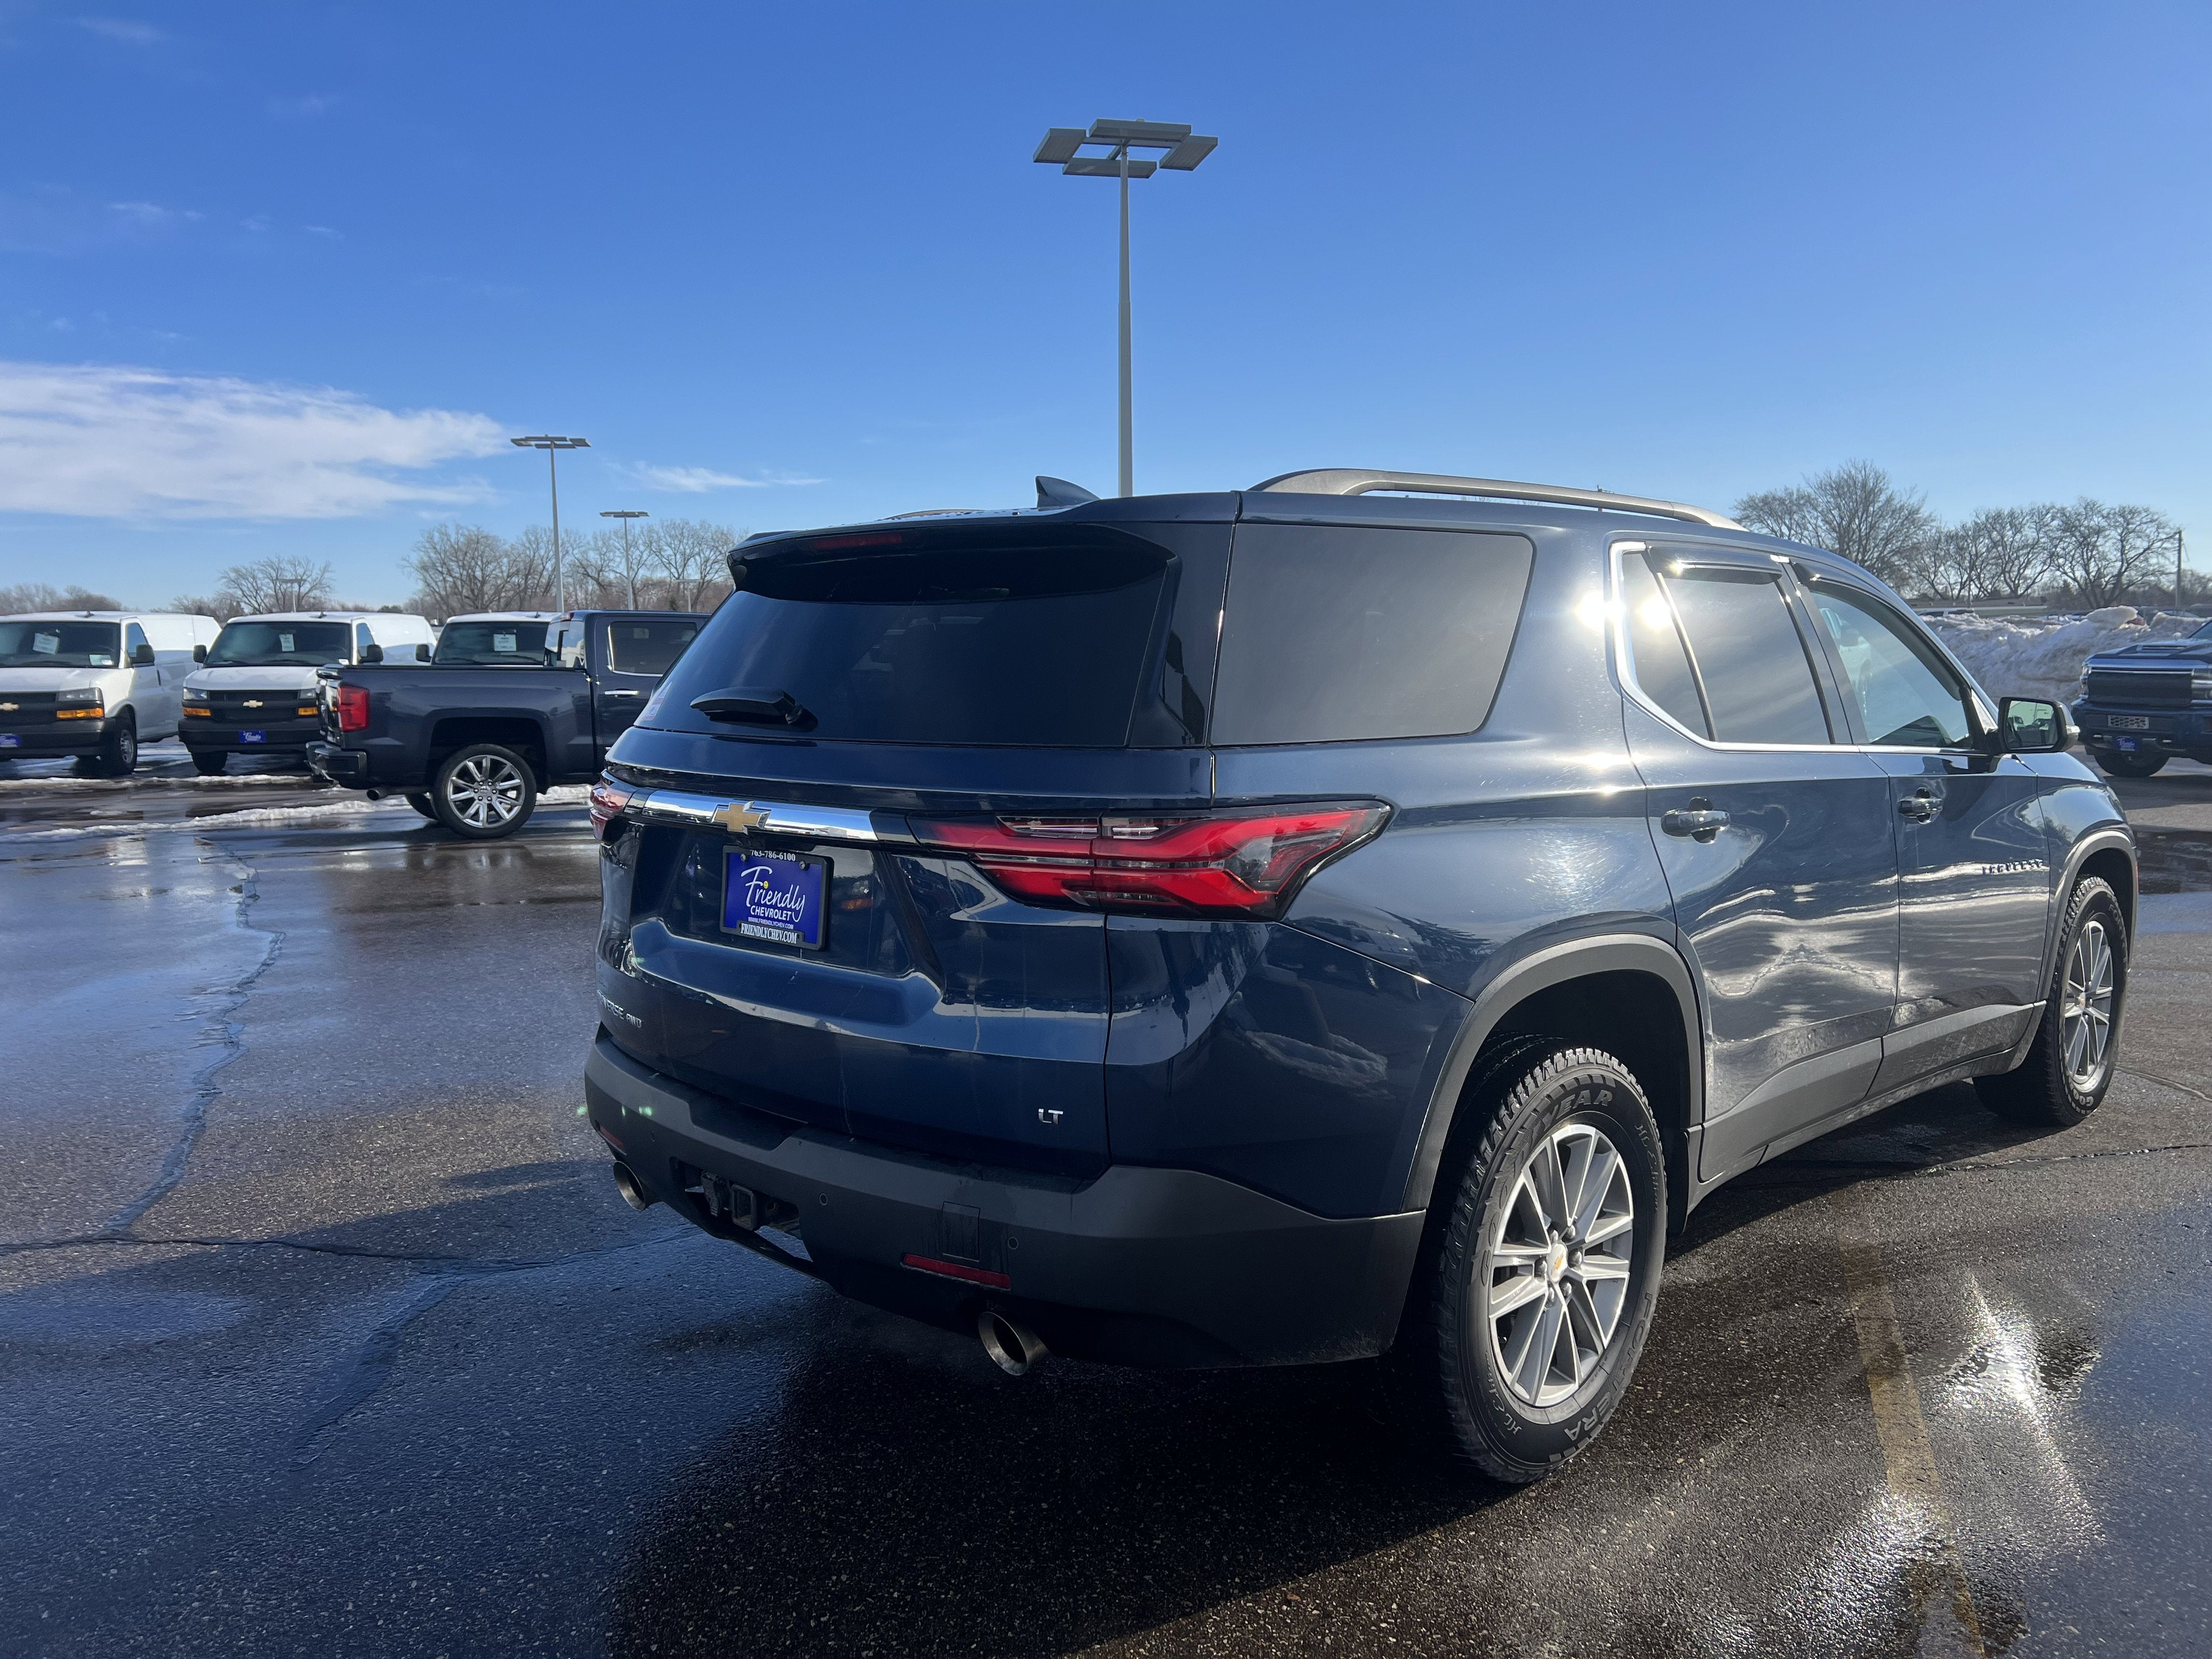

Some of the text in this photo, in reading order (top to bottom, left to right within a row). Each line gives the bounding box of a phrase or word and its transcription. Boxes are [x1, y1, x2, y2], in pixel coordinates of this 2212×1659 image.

[750, 849, 795, 861] 763-786-6100
[741, 866, 805, 922] Friendly
[750, 905, 792, 921] CHEVROLET
[741, 923, 797, 944] FRIENDLYCHEV.COM
[1038, 1108, 1064, 1125] LT
